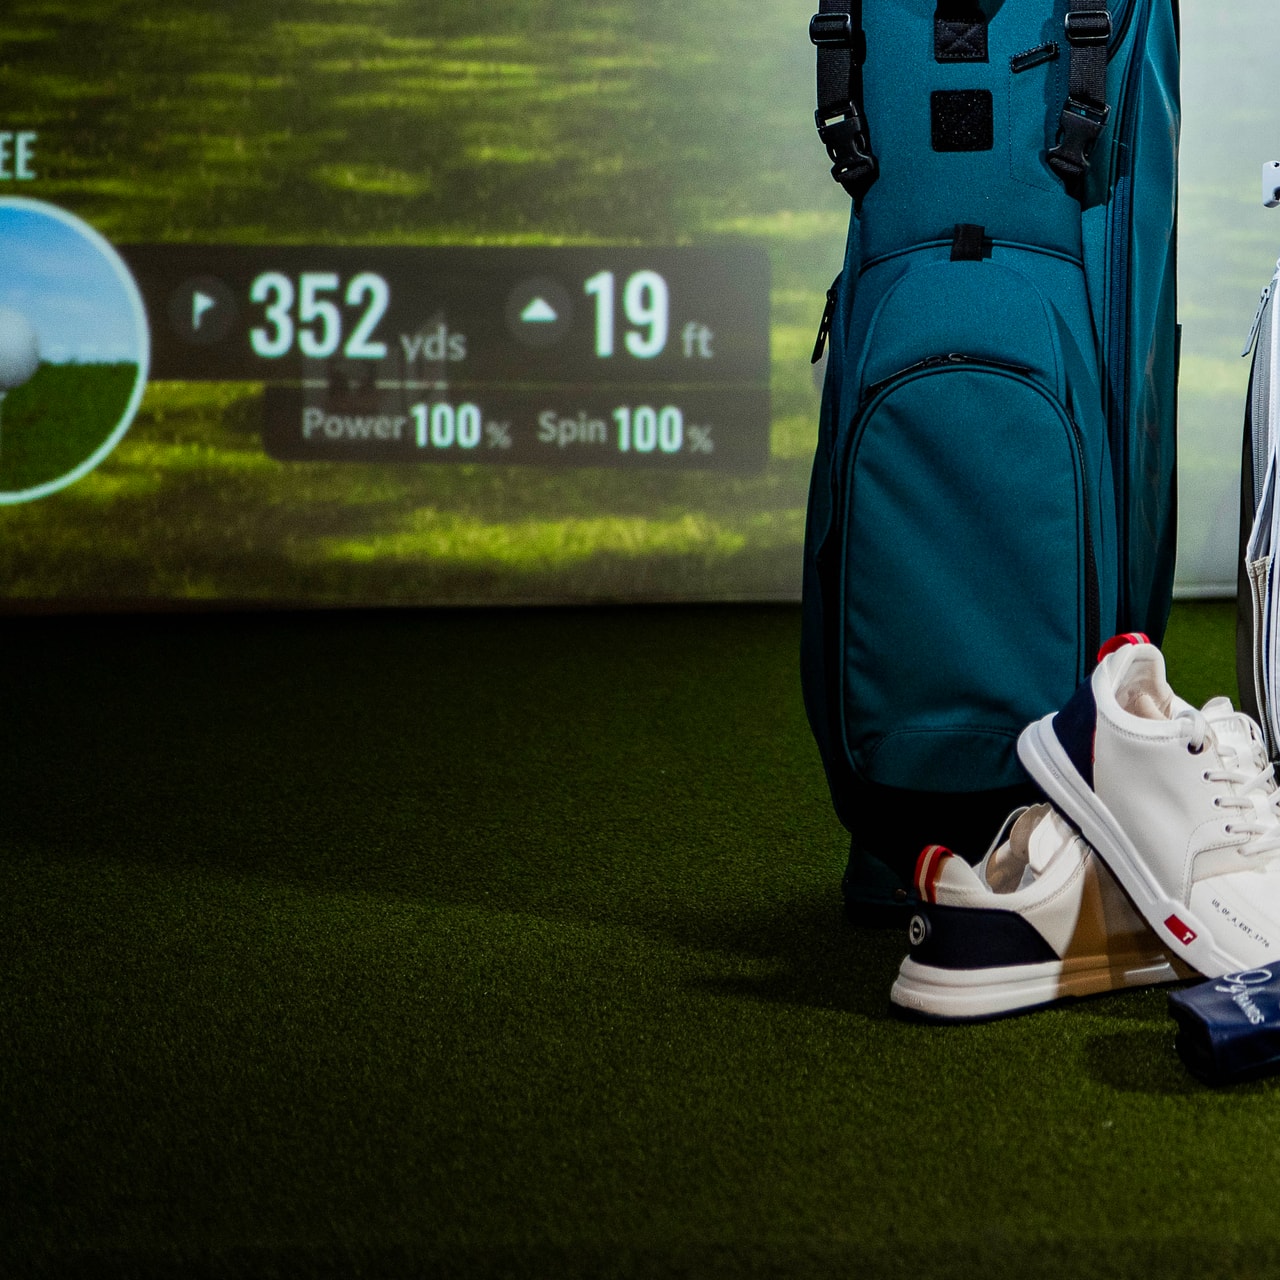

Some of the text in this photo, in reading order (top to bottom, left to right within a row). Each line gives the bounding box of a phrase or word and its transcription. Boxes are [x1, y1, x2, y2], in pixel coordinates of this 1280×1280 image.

[249, 270, 714, 363] 352 yds 19 ft
[302, 409, 407, 442] Power
[410, 403, 482, 449] 100
[537, 412, 607, 446] Spin
[613, 406, 682, 453] 100
